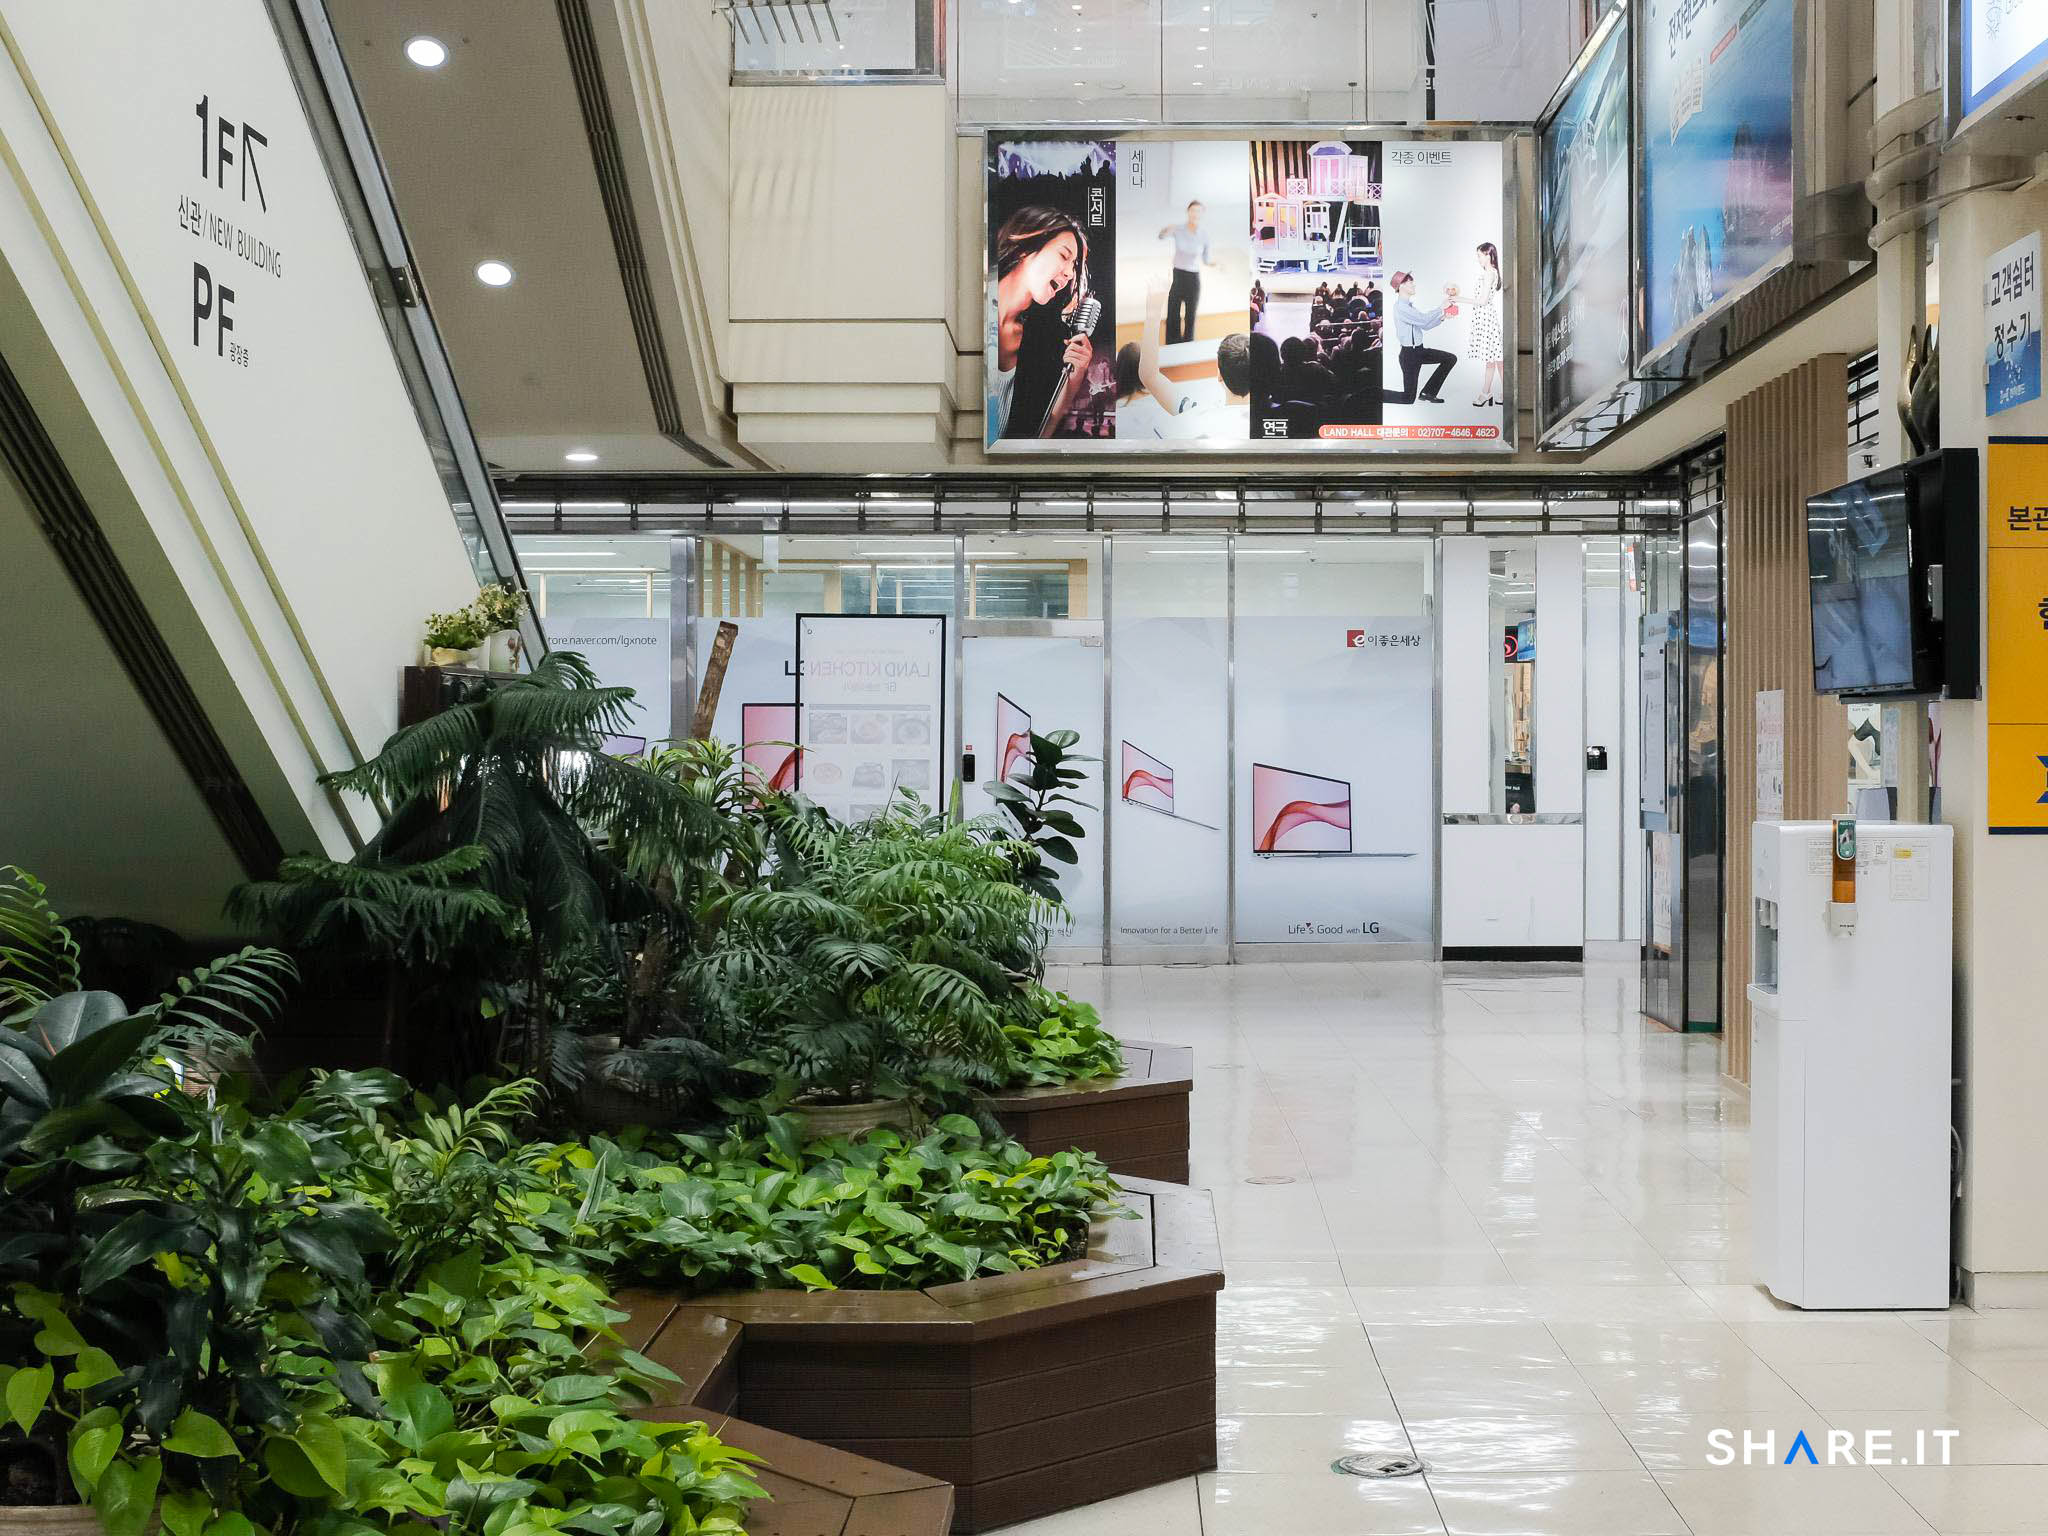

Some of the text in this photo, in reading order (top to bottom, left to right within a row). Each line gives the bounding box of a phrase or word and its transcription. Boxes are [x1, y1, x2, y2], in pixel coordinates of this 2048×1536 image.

[196, 94, 235, 190] 1F
[1391, 151, 1453, 164] 각종 이벤트
[1131, 149, 1144, 188] 세미나
[1090, 187, 1103, 226] 콘서트
[237, 229, 282, 279] BUILDING
[1991, 250, 2034, 307] 고객쉼터
[193, 261, 235, 358] PF
[1993, 312, 2031, 360] 정수기
[1263, 421, 1288, 436] 연극
[1323, 428, 1348, 437] LAND
[1351, 428, 1375, 437] HALL
[1475, 428, 1496, 437] 4623
[1367, 634, 1421, 647] 이좋은세상
[1120, 927, 1159, 935] Innovation
[1160, 926, 1171, 935] for
[1180, 927, 1203, 935] Better
[1205, 926, 1219, 935] Life
[1317, 924, 1343, 935] Good
[1362, 921, 1380, 934] LG
